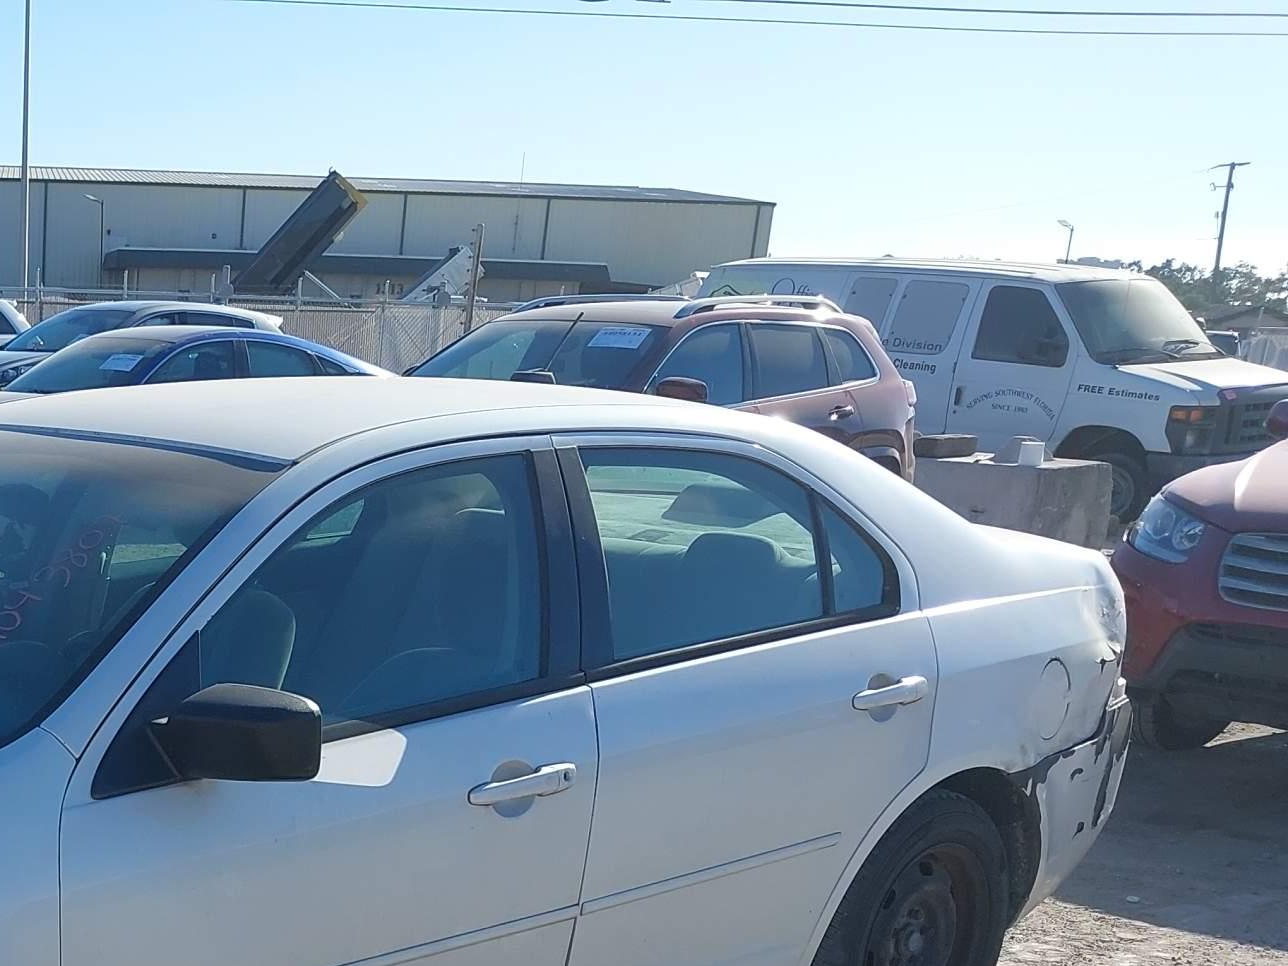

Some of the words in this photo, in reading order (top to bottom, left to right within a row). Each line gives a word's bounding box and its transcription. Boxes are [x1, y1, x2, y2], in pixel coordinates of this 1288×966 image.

[892, 337, 942, 351] Division
[893, 358, 937, 375] Cleaning
[993, 388, 1034, 401] SOUTHWEST
[1078, 383, 1105, 395] FREE
[1108, 387, 1161, 402] Estimates
